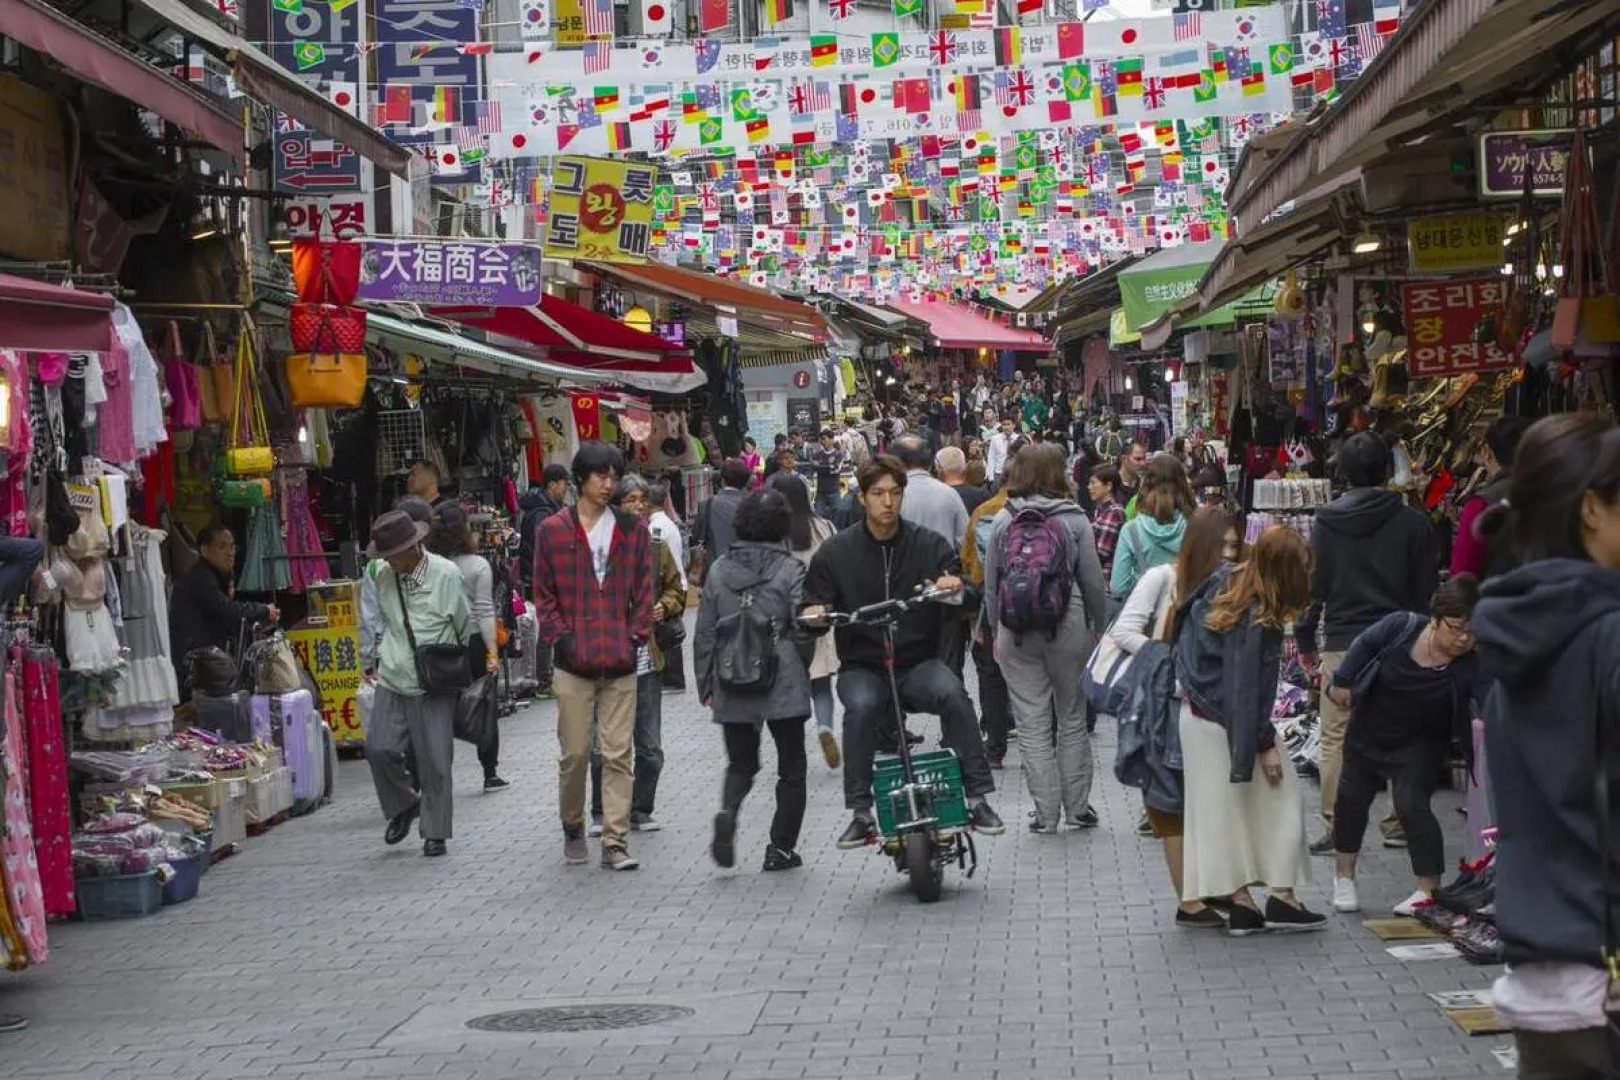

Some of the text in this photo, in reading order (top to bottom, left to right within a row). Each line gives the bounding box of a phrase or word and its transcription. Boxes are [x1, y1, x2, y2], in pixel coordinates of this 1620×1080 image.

[379, 244, 511, 286] 大福商会
[318, 676, 361, 692] CHANGE
